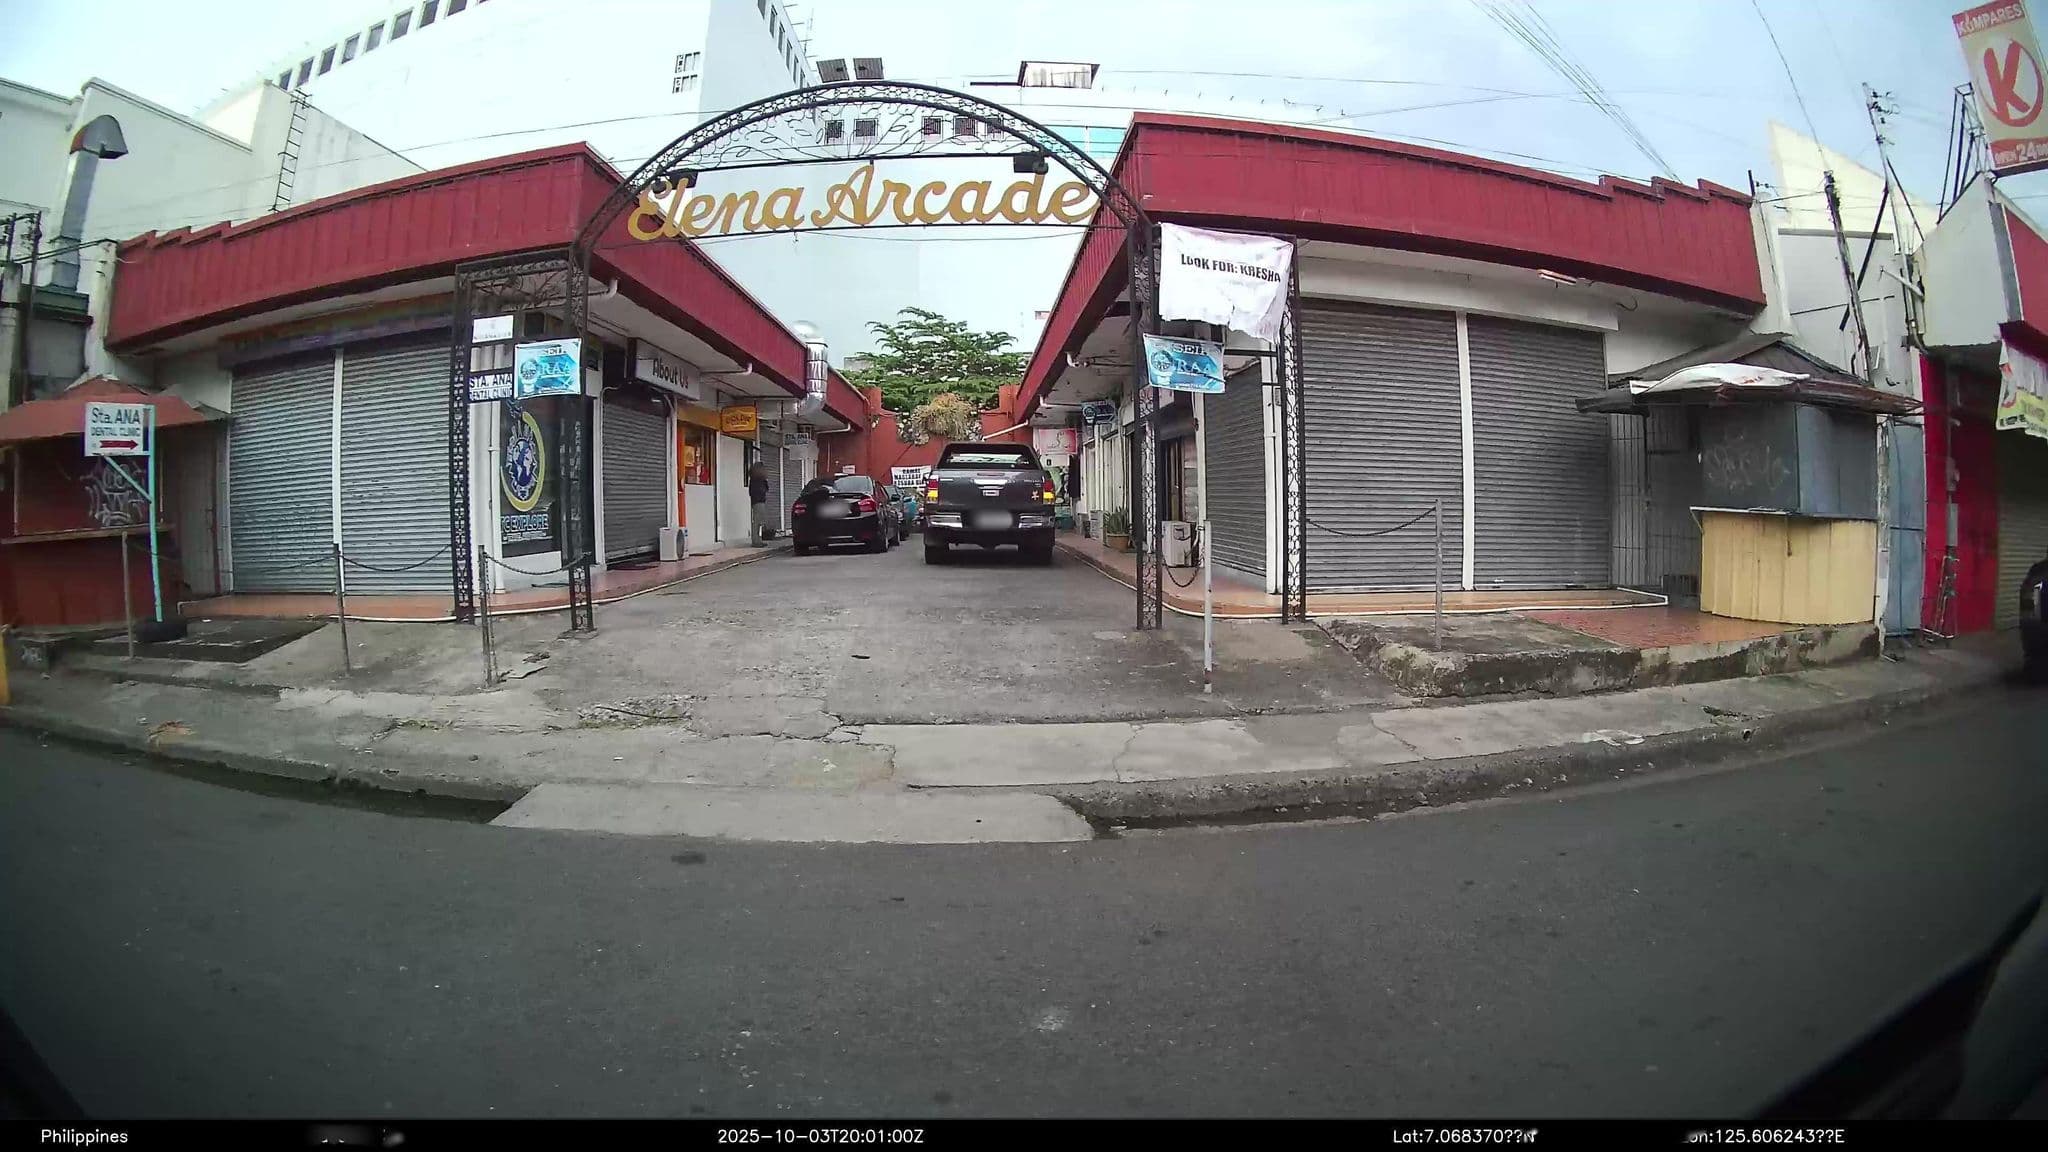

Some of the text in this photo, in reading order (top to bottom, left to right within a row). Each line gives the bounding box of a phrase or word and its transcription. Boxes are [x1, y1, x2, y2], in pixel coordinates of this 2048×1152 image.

[2016, 142, 2038, 161] 24
[627, 165, 1102, 241] Elena Arcade
[1181, 253, 1281, 283] LOOK FOR: KRESHA
[493, 373, 512, 386] ANA
[652, 357, 689, 389] About Us
[91, 407, 140, 424] Sta. ANA
[91, 426, 118, 437] DENTAL
